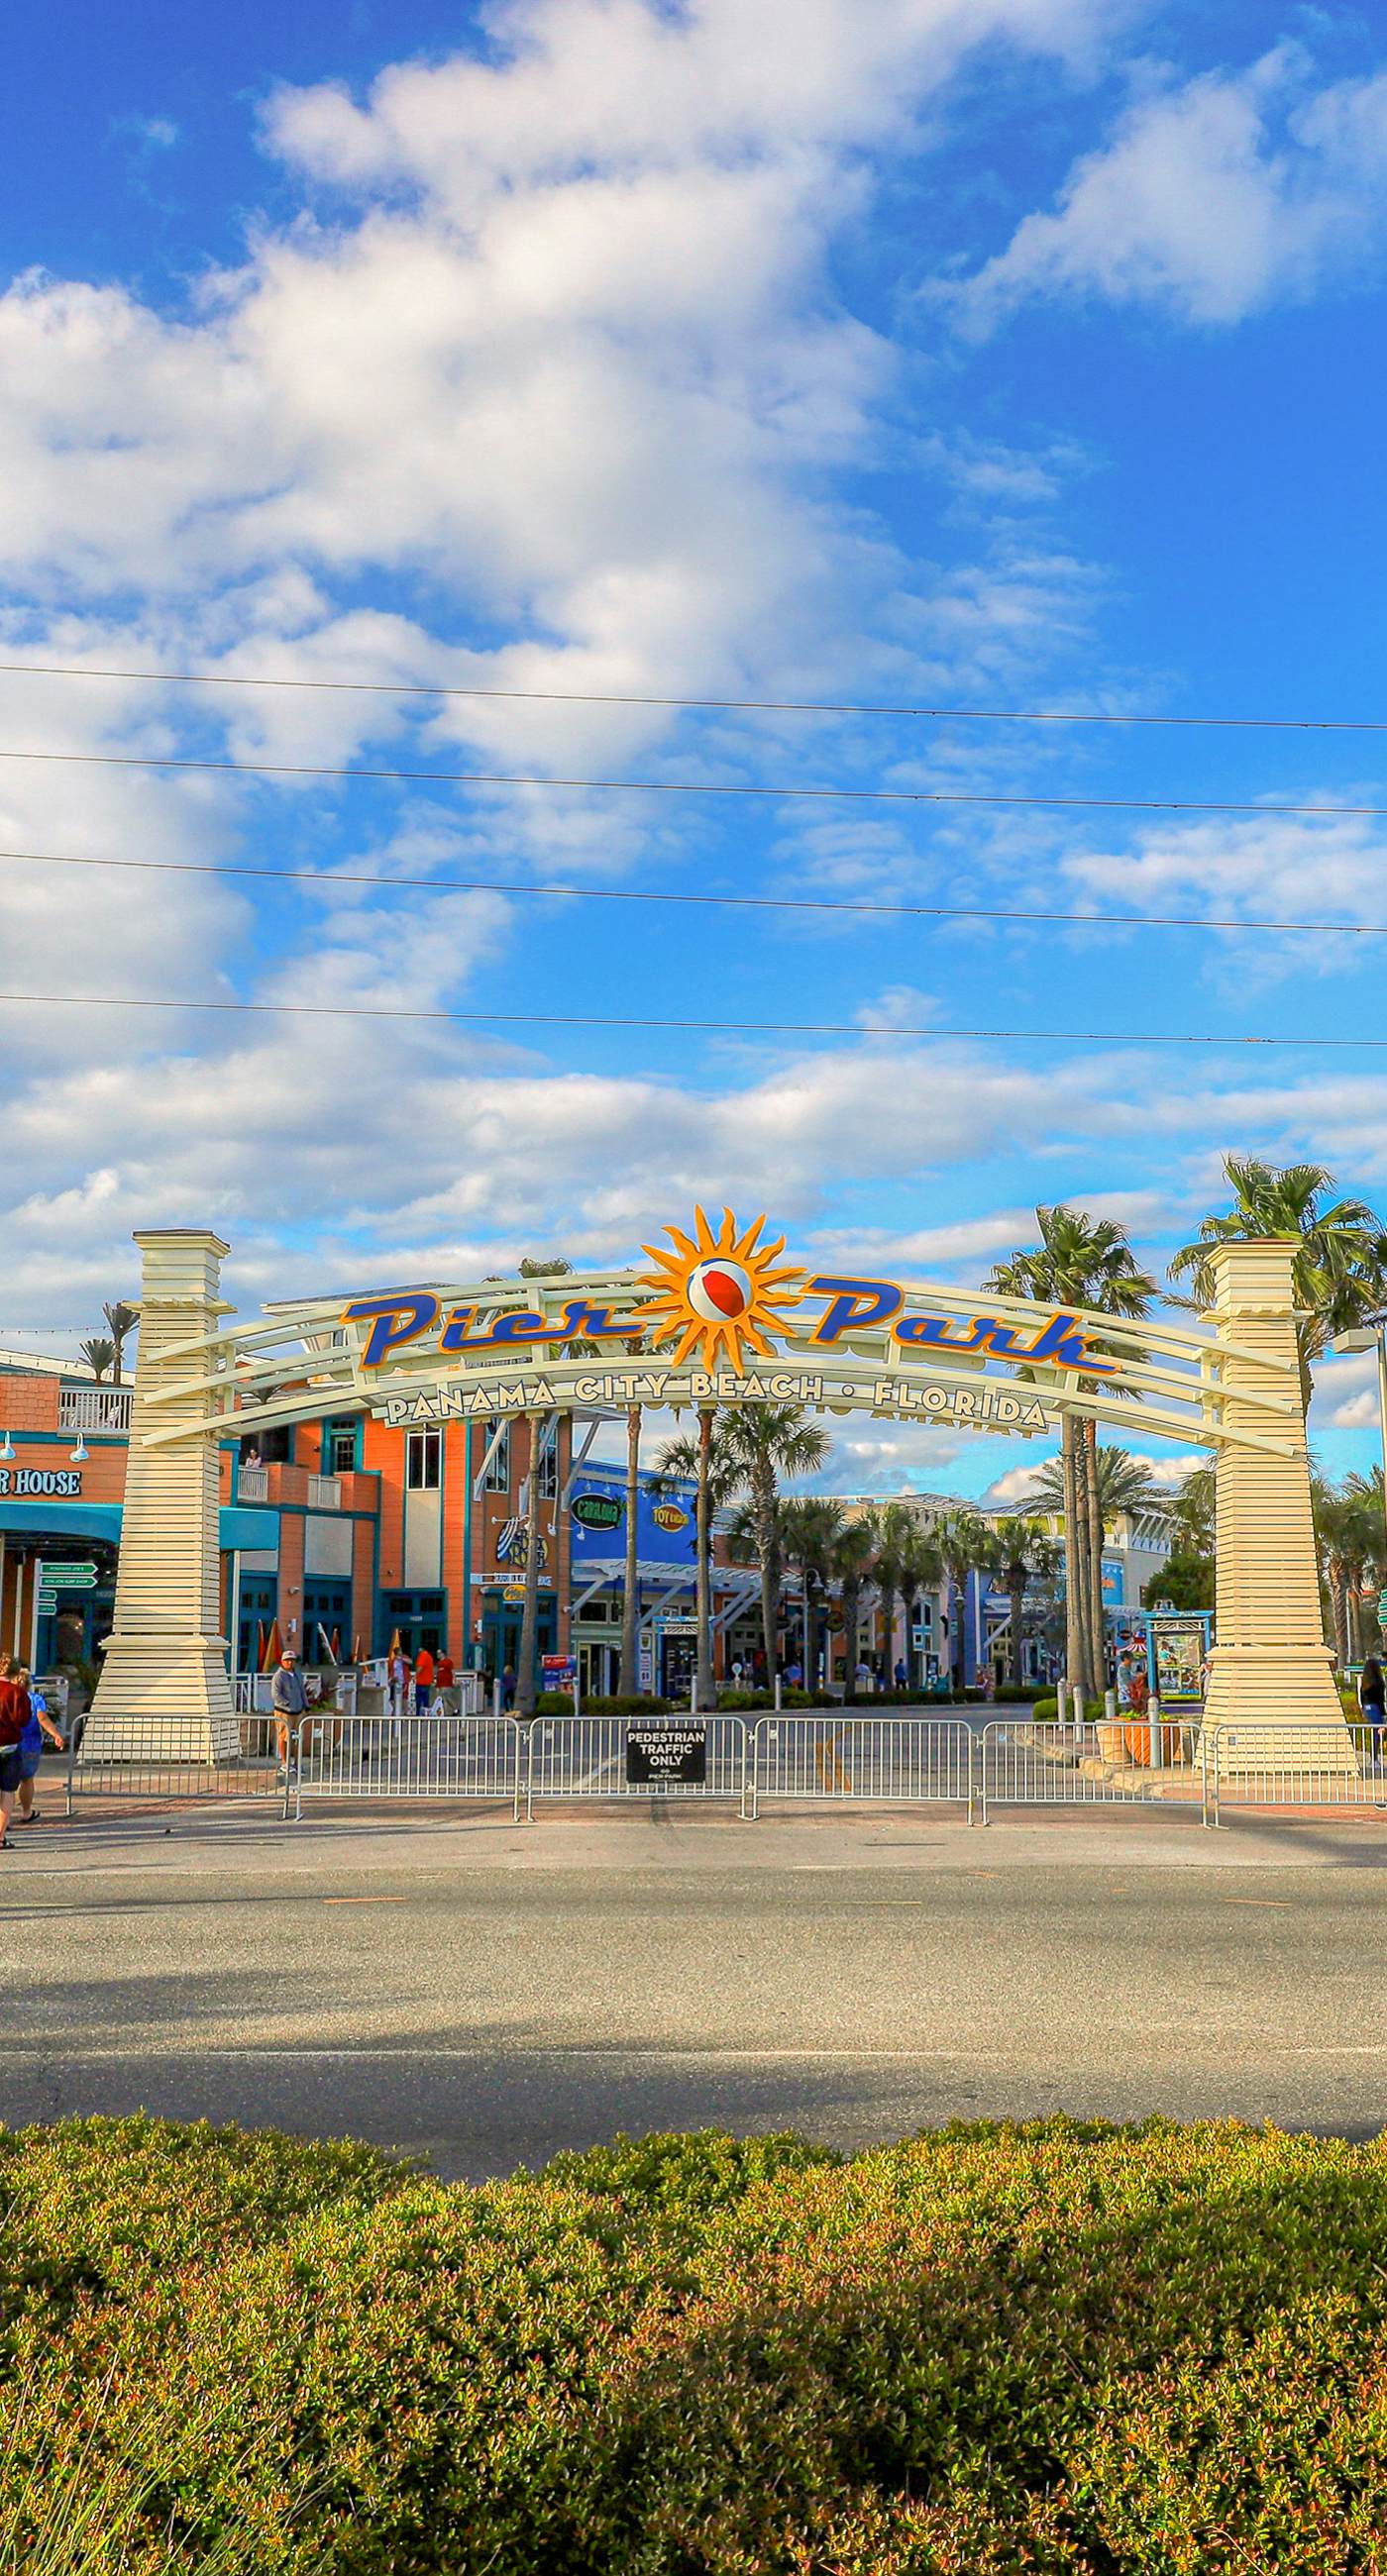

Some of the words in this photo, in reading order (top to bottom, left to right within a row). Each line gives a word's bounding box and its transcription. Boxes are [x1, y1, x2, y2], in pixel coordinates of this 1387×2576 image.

[341, 1290, 647, 1371] Pier
[800, 1274, 1121, 1376] Park
[386, 1380, 556, 1424] PANAMA
[574, 1373, 671, 1401] CITY
[690, 1372, 823, 1401] BEACH
[873, 1381, 1048, 1428] FLORIDA
[14, 1469, 81, 1496] HOUSE
[627, 1731, 705, 1743] PEDESTRIAN
[639, 1743, 694, 1755] TRAFFIC
[649, 1755, 684, 1766] ONLY
